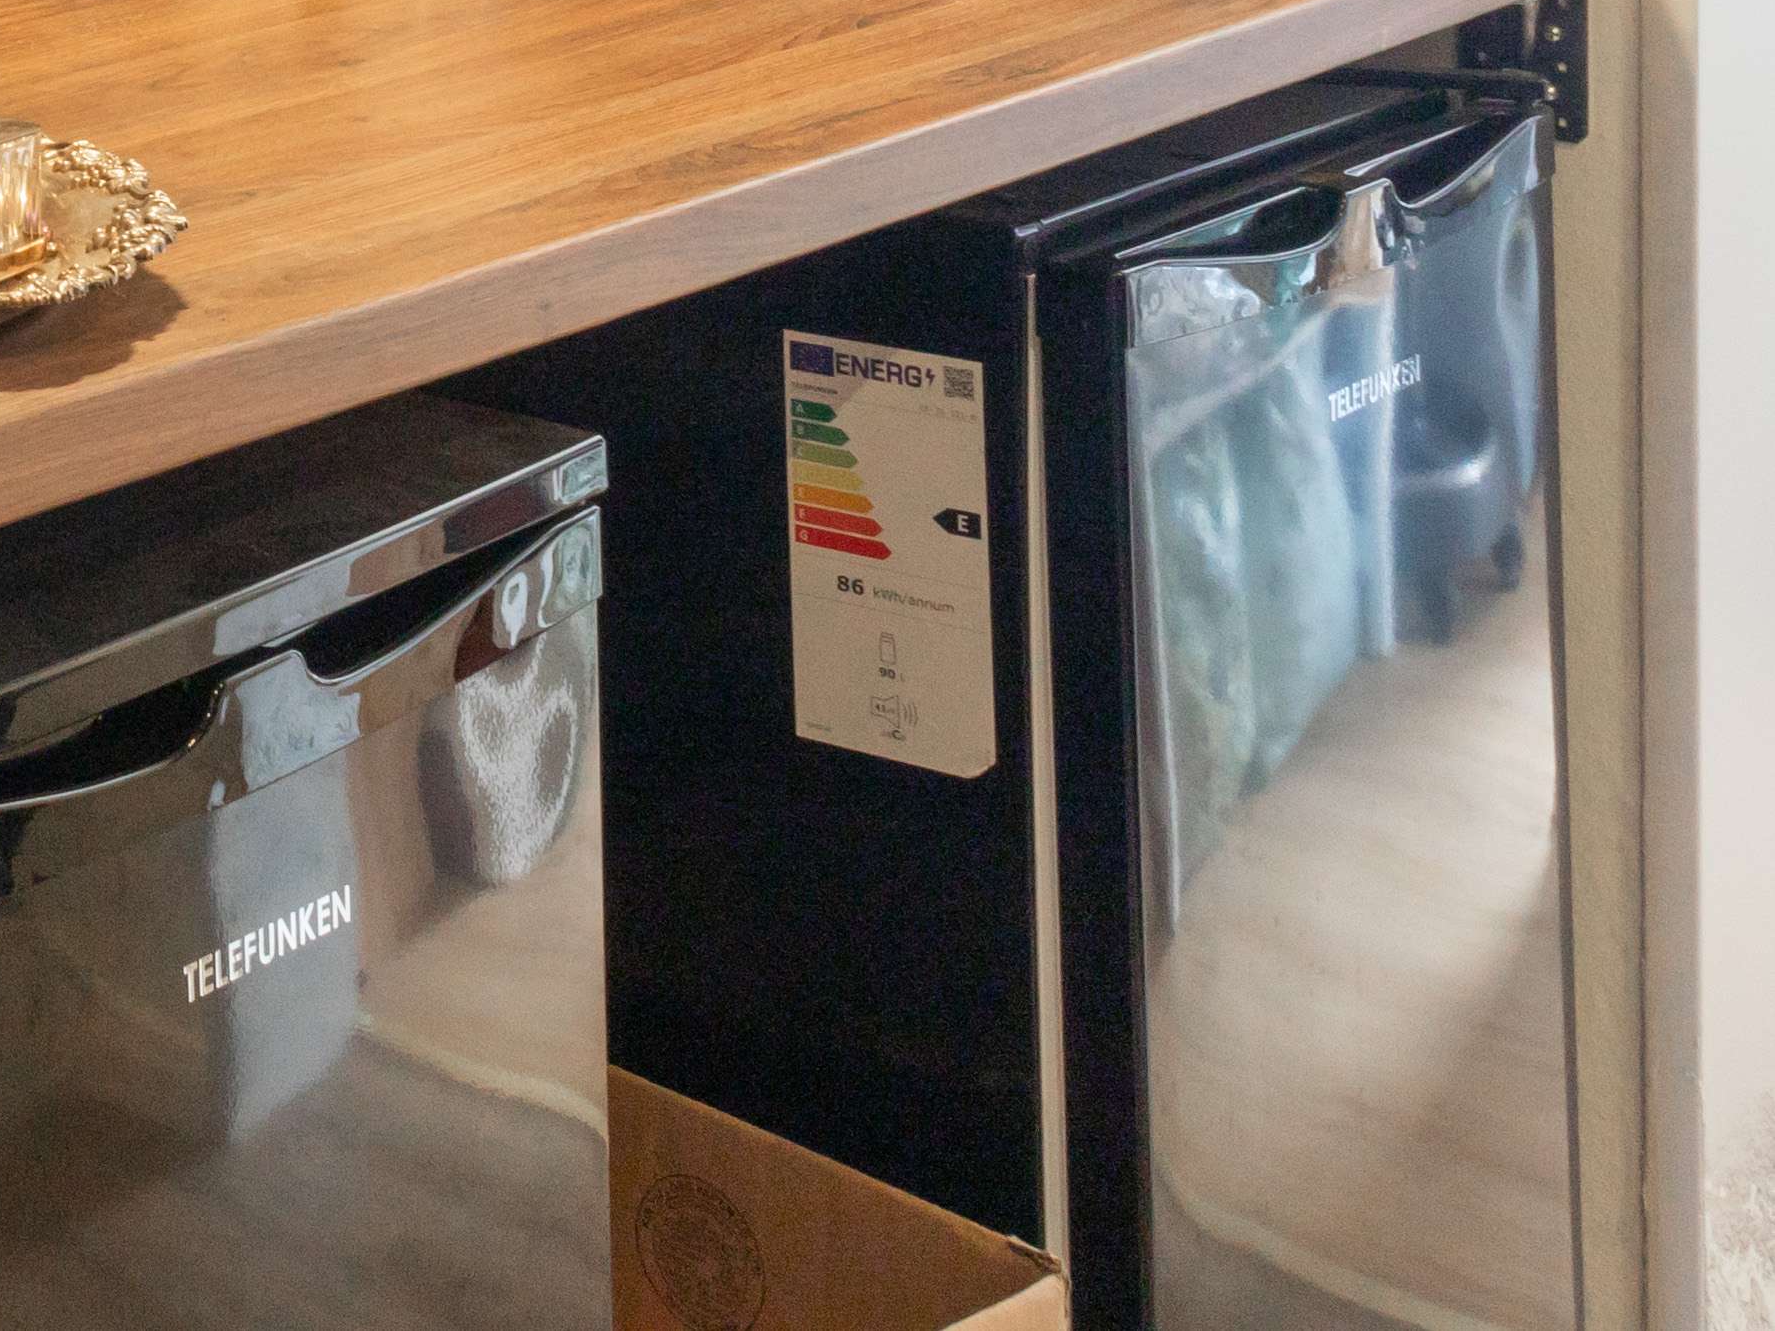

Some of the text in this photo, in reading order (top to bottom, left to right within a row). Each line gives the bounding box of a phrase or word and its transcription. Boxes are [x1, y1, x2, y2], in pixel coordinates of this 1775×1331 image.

[1329, 353, 1420, 422] TELEFUNKEN
[957, 514, 969, 533] E
[837, 575, 865, 596] 86
[183, 885, 352, 1003] TELEFUNKEN
